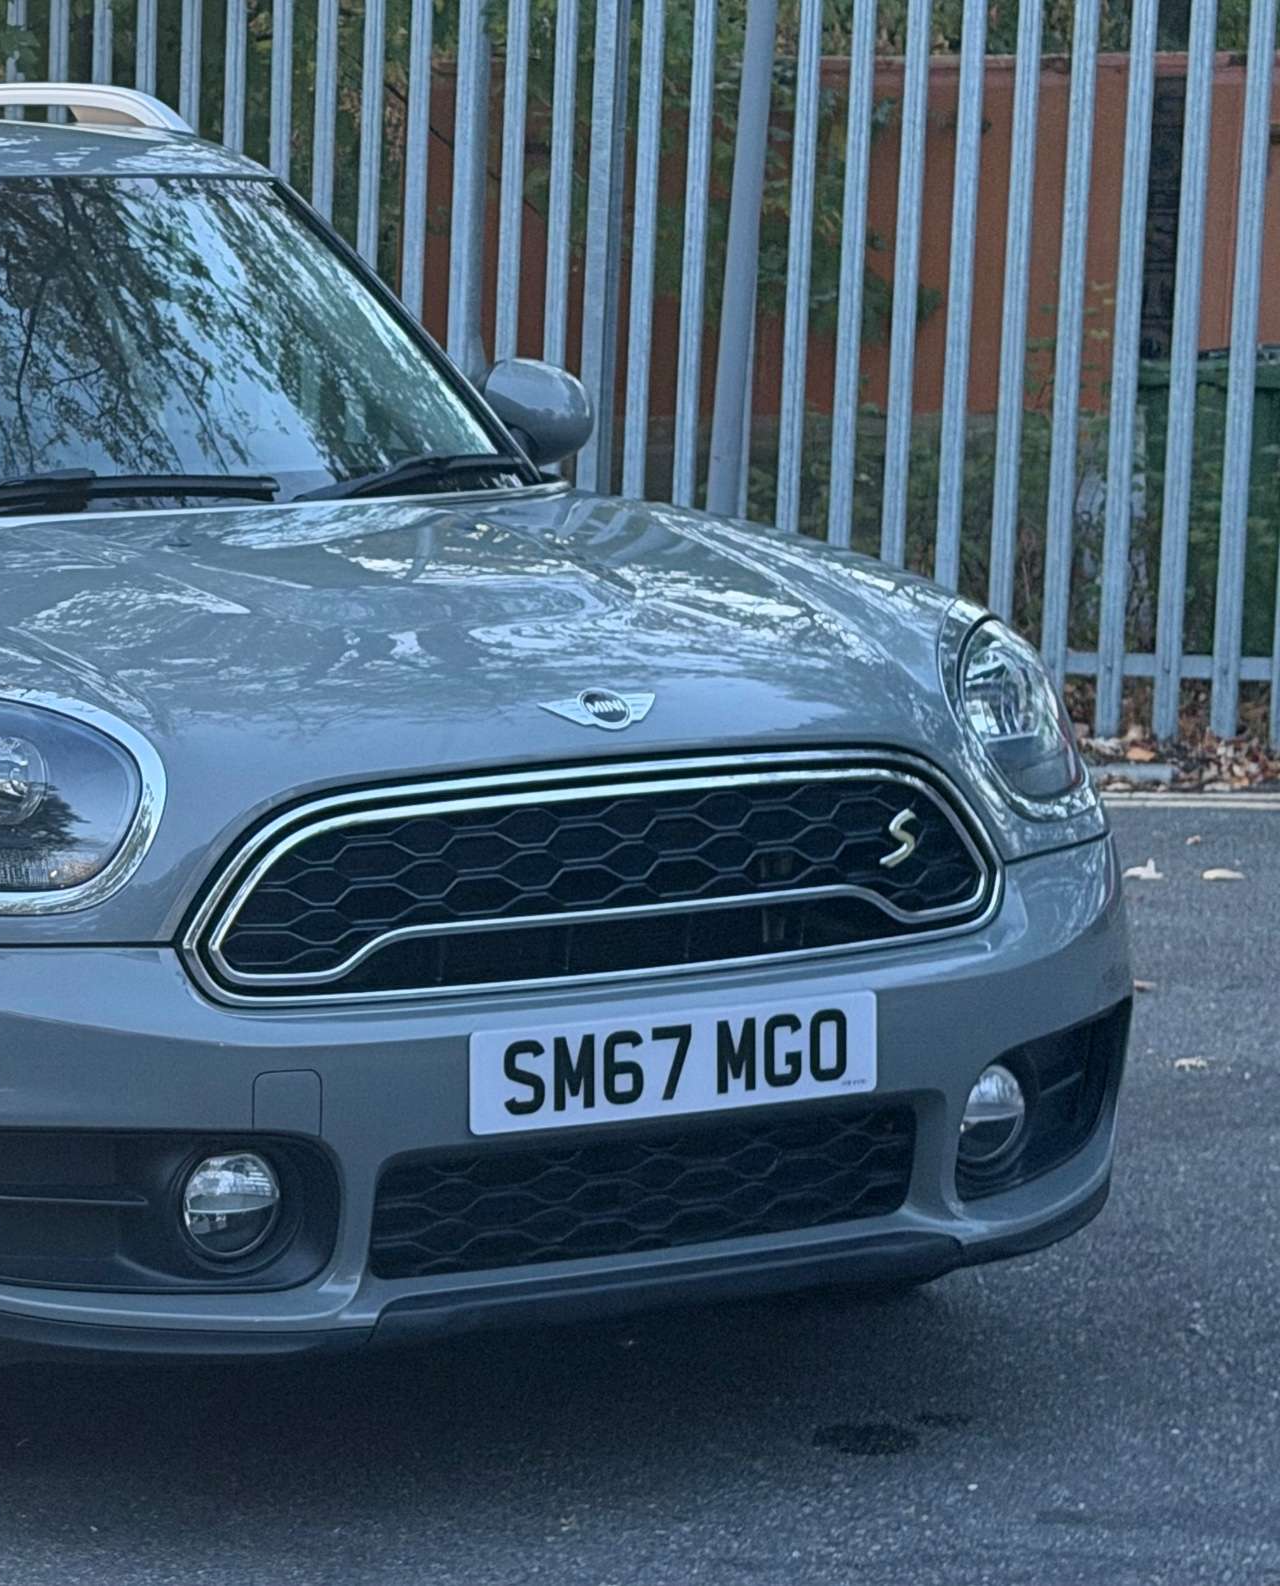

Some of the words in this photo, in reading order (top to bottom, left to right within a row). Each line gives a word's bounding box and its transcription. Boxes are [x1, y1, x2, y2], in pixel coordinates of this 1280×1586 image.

[585, 699, 625, 713] MINI
[879, 808, 916, 868] S
[503, 1023, 692, 1116] SM67
[716, 1007, 848, 1096] MGO
